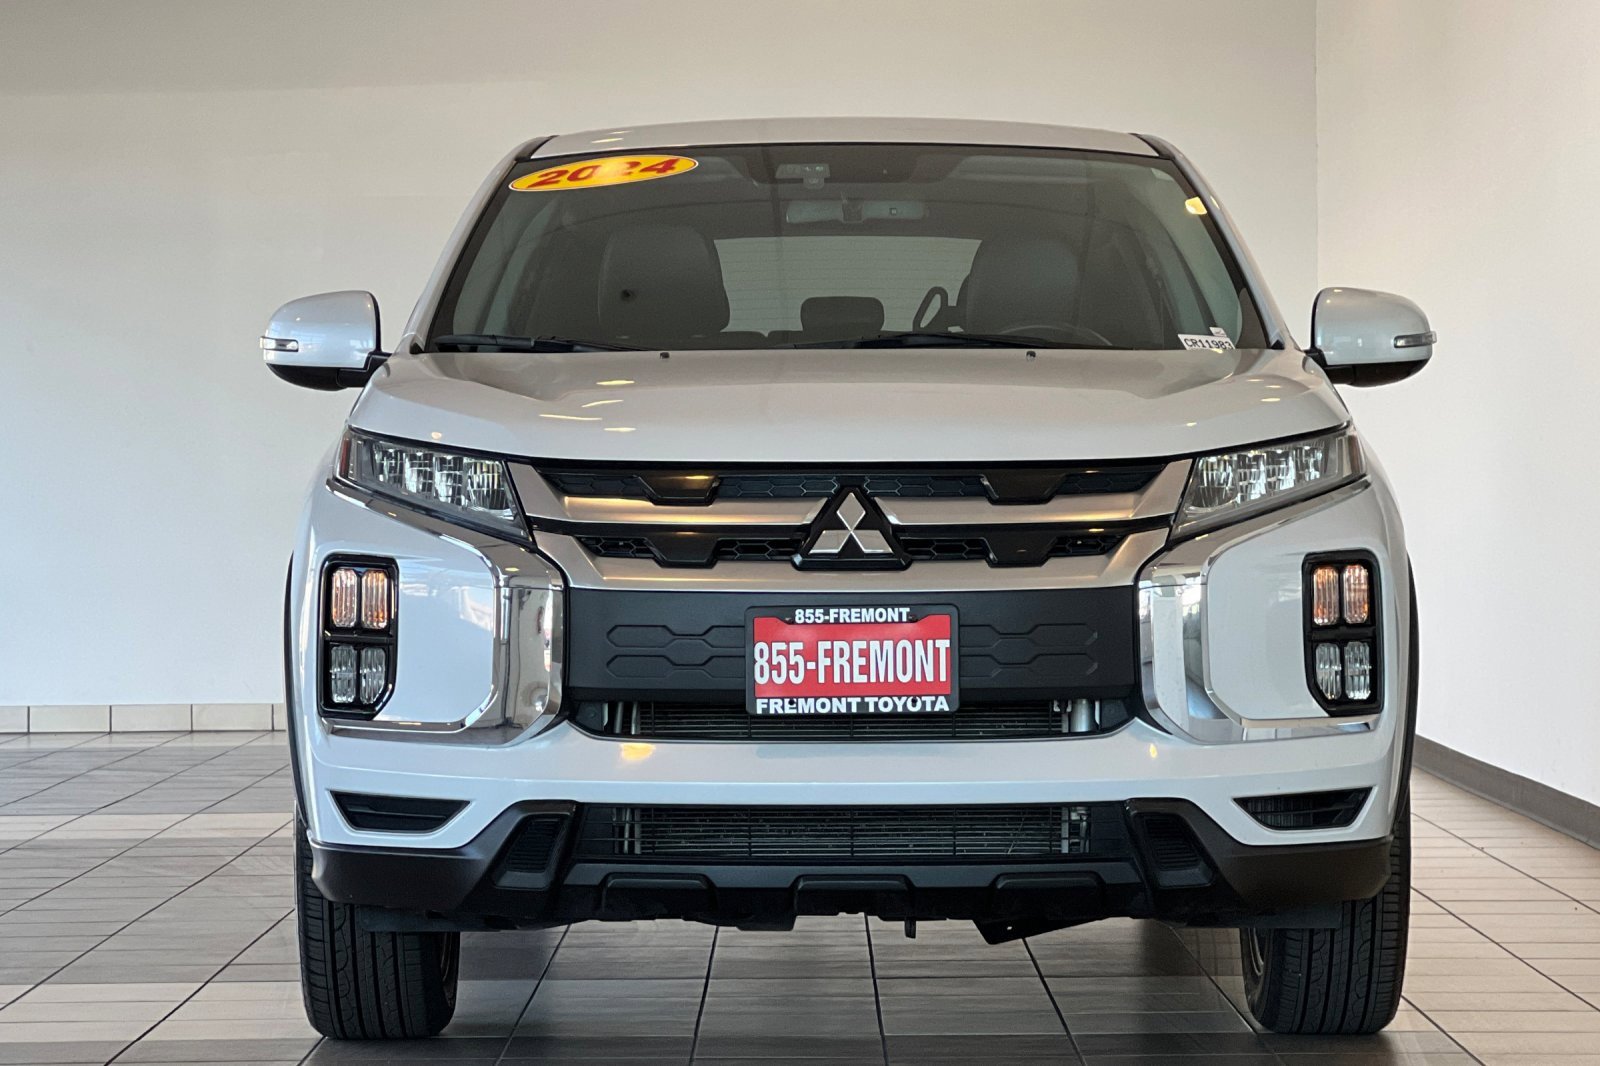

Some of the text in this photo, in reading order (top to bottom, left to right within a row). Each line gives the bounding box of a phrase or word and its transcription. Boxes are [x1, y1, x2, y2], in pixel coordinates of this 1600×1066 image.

[795, 607, 910, 623] 855-FREMONT
[753, 639, 950, 684] 855-FREMONT
[756, 696, 949, 714] FREMONT TOYOTA
